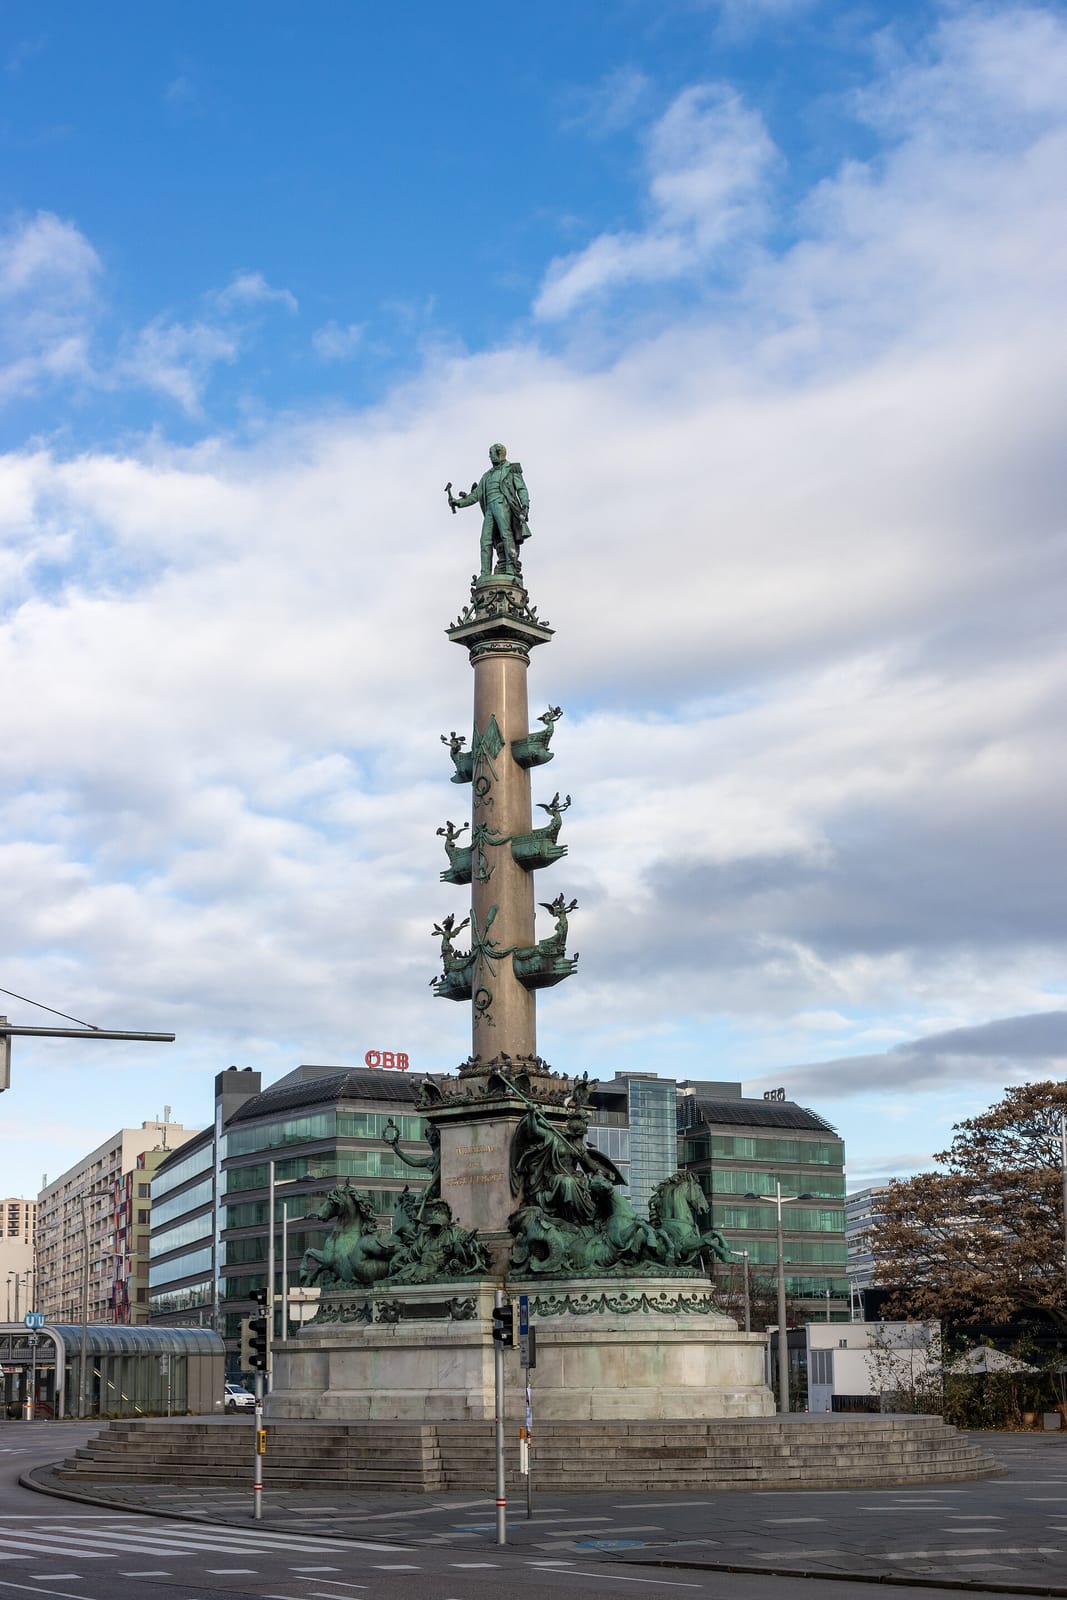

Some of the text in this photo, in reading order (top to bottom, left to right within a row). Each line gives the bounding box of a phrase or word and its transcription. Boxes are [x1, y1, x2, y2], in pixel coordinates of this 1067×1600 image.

[365, 1050, 409, 1070] ÖBB
[26, 1316, 35, 1327] U
[38, 1316, 44, 1327] U
